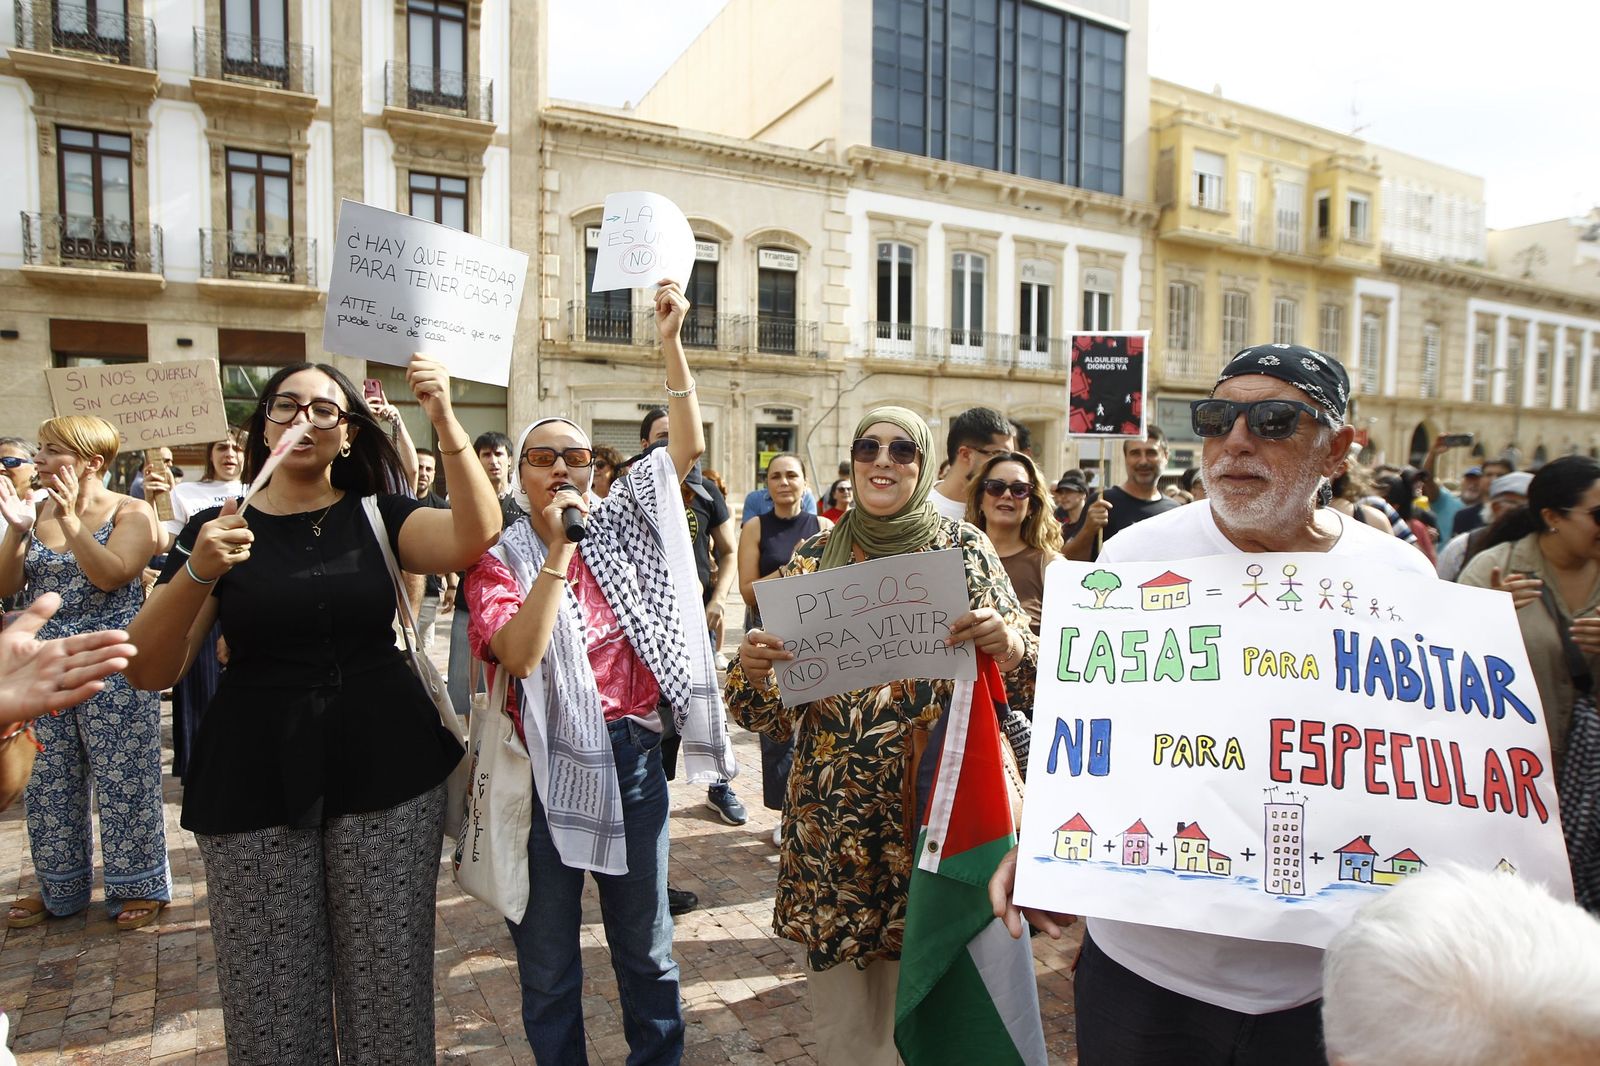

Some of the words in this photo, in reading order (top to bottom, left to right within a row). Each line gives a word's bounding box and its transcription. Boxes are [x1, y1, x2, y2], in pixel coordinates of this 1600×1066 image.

[623, 205, 653, 224] LA
[608, 229, 635, 247] ES
[413, 246, 447, 267] QUE
[454, 255, 516, 292] HEREDAR
[630, 250, 653, 267] NO
[349, 254, 397, 282] PARA
[405, 268, 459, 297] TENER
[337, 313, 371, 328] puede
[376, 319, 399, 334] irse
[406, 327, 420, 339] de
[391, 306, 407, 322] La
[471, 327, 485, 342] que
[489, 332, 502, 342] no
[66, 371, 88, 392] SI
[100, 370, 136, 388] NOS
[146, 364, 200, 385] QUIEREN
[1087, 363, 1115, 371] DIGNOS
[73, 397, 101, 411] SIN
[110, 391, 159, 407] CASAS
[114, 405, 179, 425] TENDRÁN
[192, 403, 209, 417] EN
[140, 422, 197, 441] CALLES
[867, 610, 951, 640] VIVIR
[1056, 624, 1222, 684] CASAS
[1243, 646, 1320, 681] PARA
[789, 662, 823, 685] NO
[1046, 717, 1111, 777] NO
[1153, 733, 1246, 771] PARA
[1269, 717, 1549, 825] ESPECULAR
